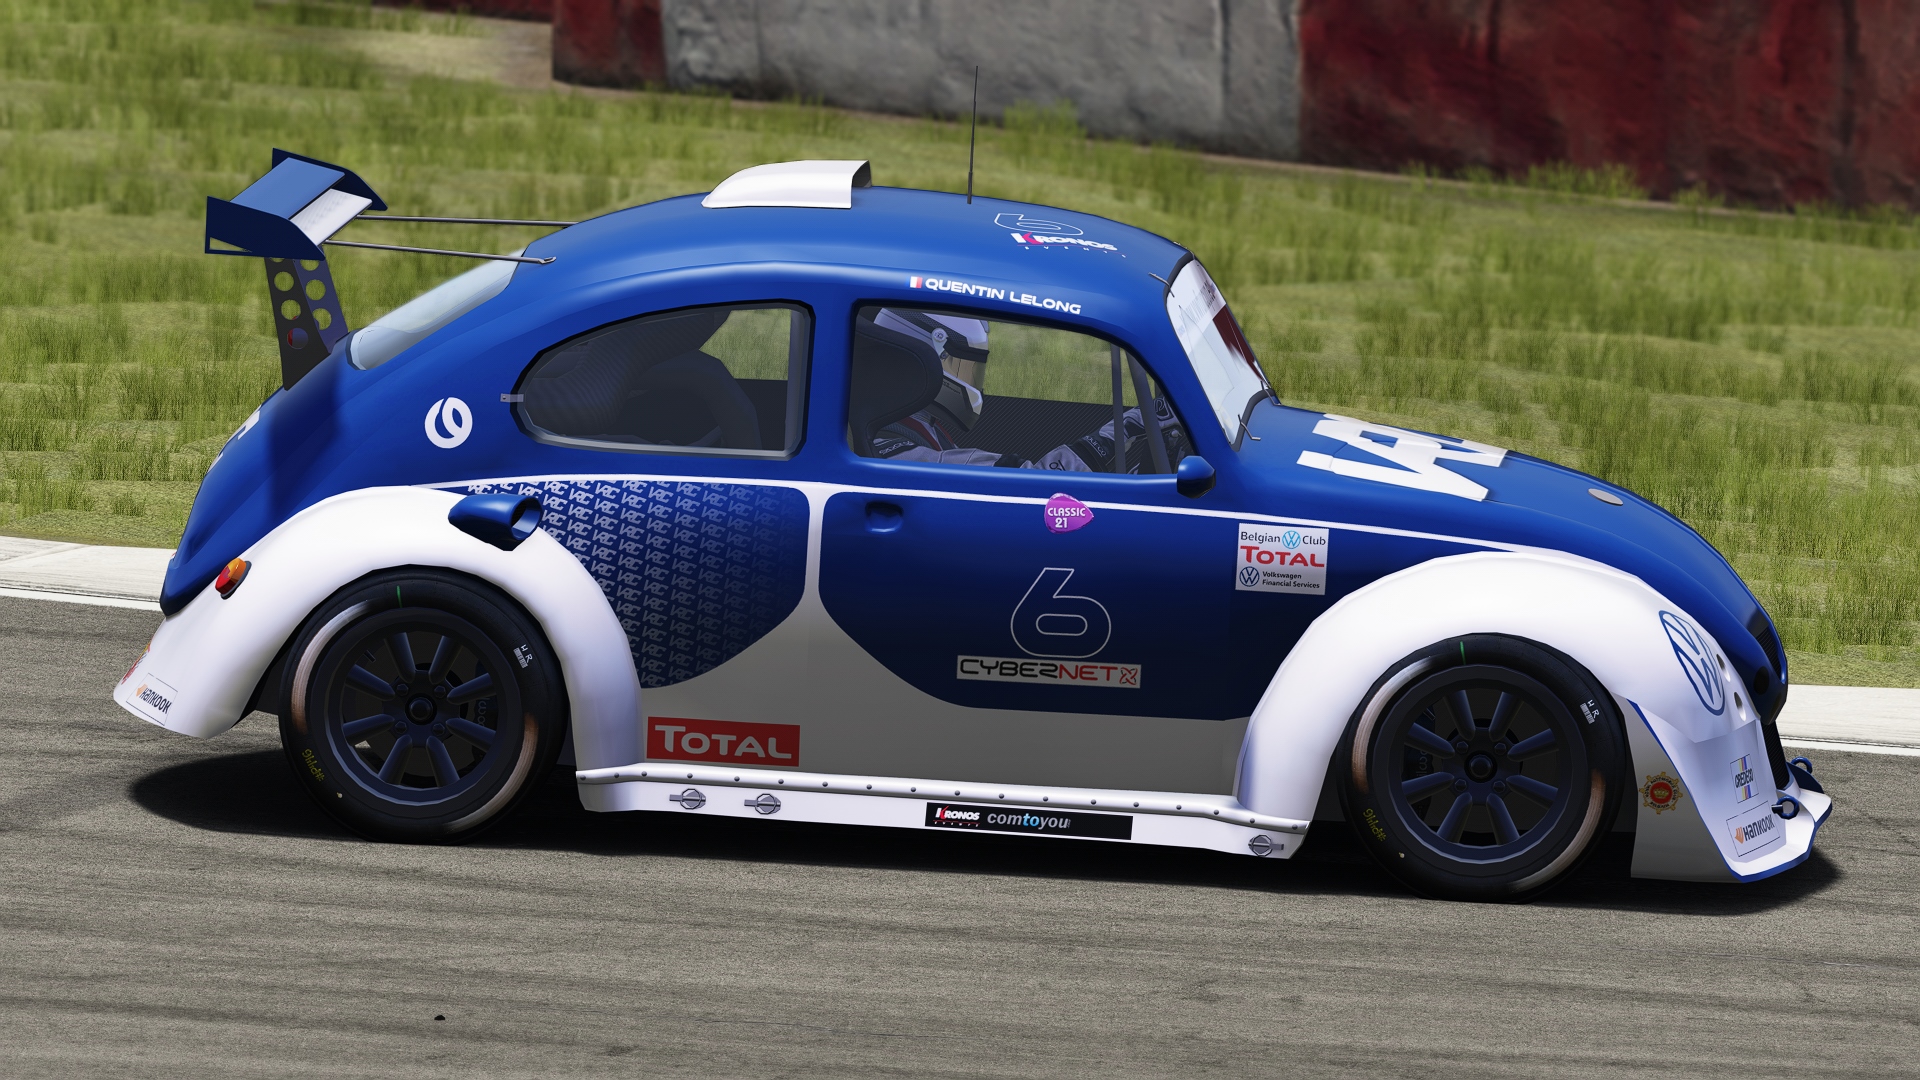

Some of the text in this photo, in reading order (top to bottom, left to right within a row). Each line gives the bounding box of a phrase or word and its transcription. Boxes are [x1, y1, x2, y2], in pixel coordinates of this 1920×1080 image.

[925, 278, 1082, 315] QUENTIN LELONG
[1047, 507, 1086, 517] CLASSIC
[1054, 517, 1068, 529] 21
[1240, 531, 1280, 544] Belgian
[1302, 535, 1326, 546] Club
[1240, 545, 1325, 567] TOTAL
[1262, 571, 1302, 580] Volkswagen
[1262, 579, 1320, 589] Financial Services
[1010, 567, 1112, 659] 6
[654, 724, 792, 760] TOTAL
[935, 805, 980, 820] KRONOS
[987, 812, 1068, 830] comtoyou
